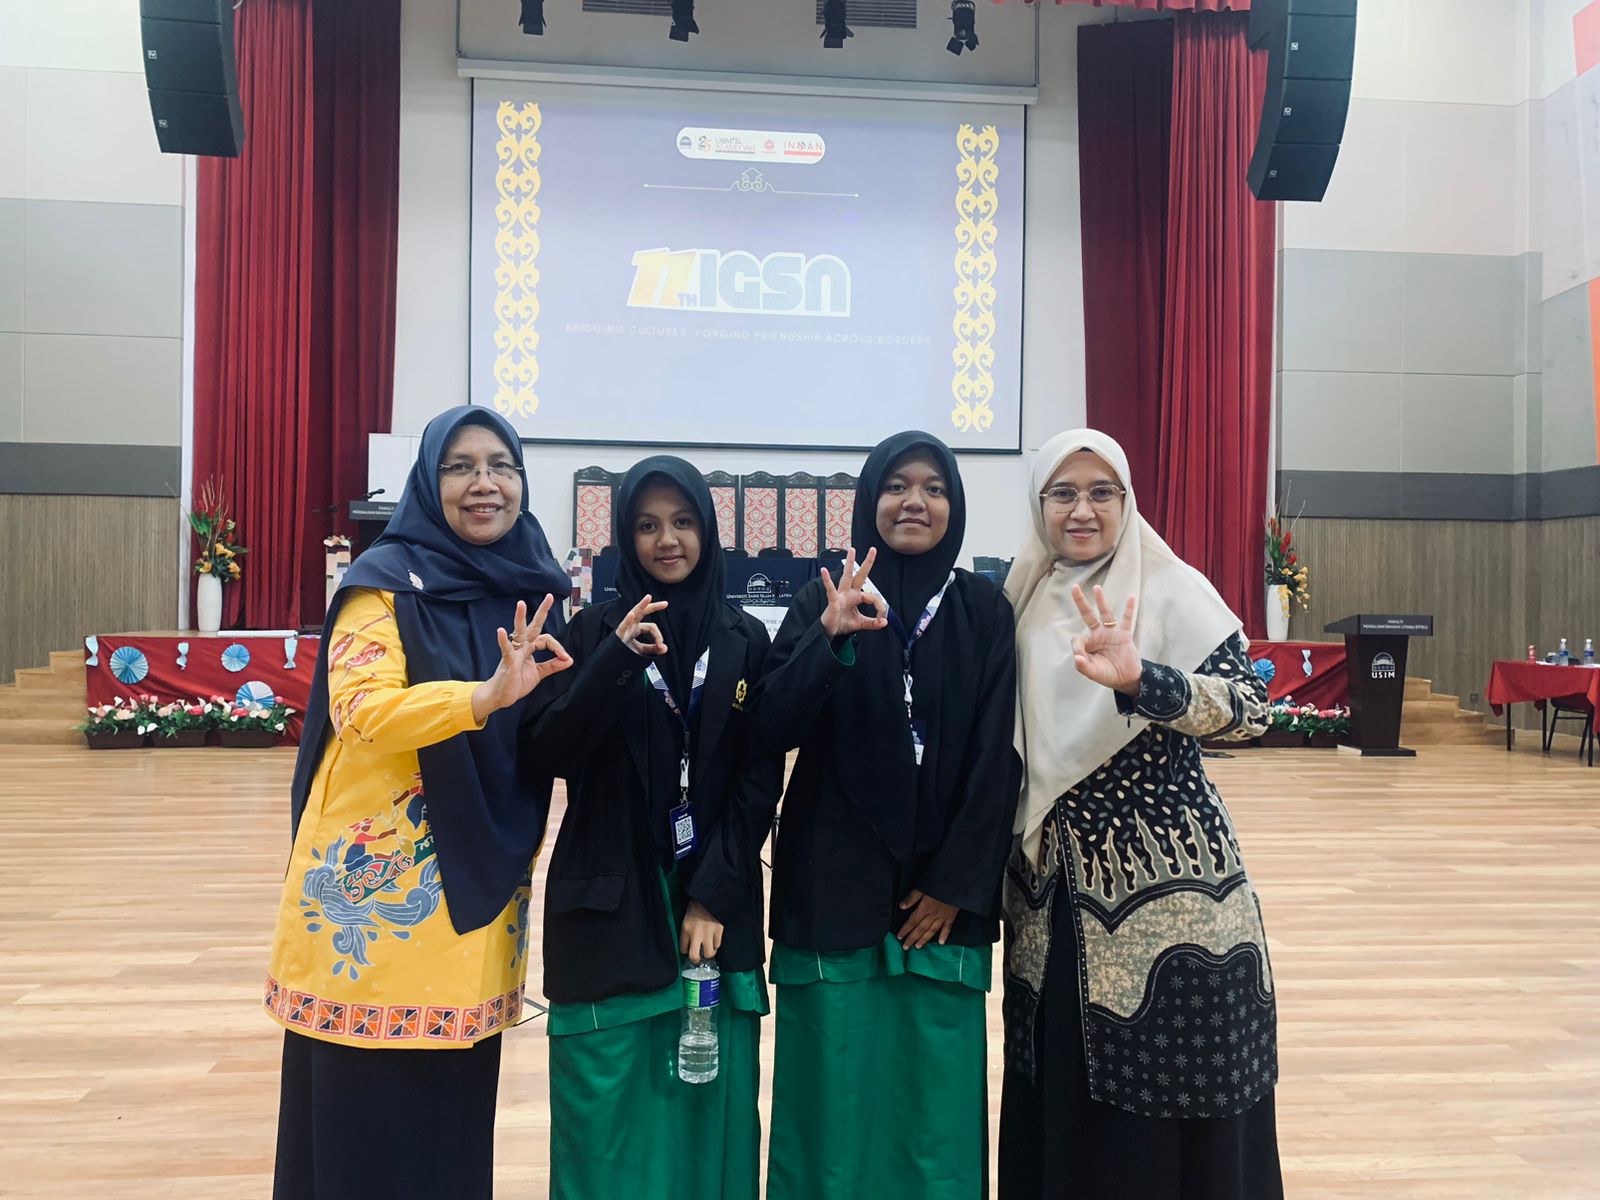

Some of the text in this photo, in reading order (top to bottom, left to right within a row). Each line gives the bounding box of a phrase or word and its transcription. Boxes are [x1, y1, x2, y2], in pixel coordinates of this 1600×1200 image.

[566, 323, 624, 334] BRIDGING
[695, 328, 751, 340] FORGING
[754, 331, 820, 342] FRIENDSHIP
[826, 333, 873, 344] ACROSS
[878, 335, 931, 346] BORDERS
[1371, 671, 1396, 679] USIM
